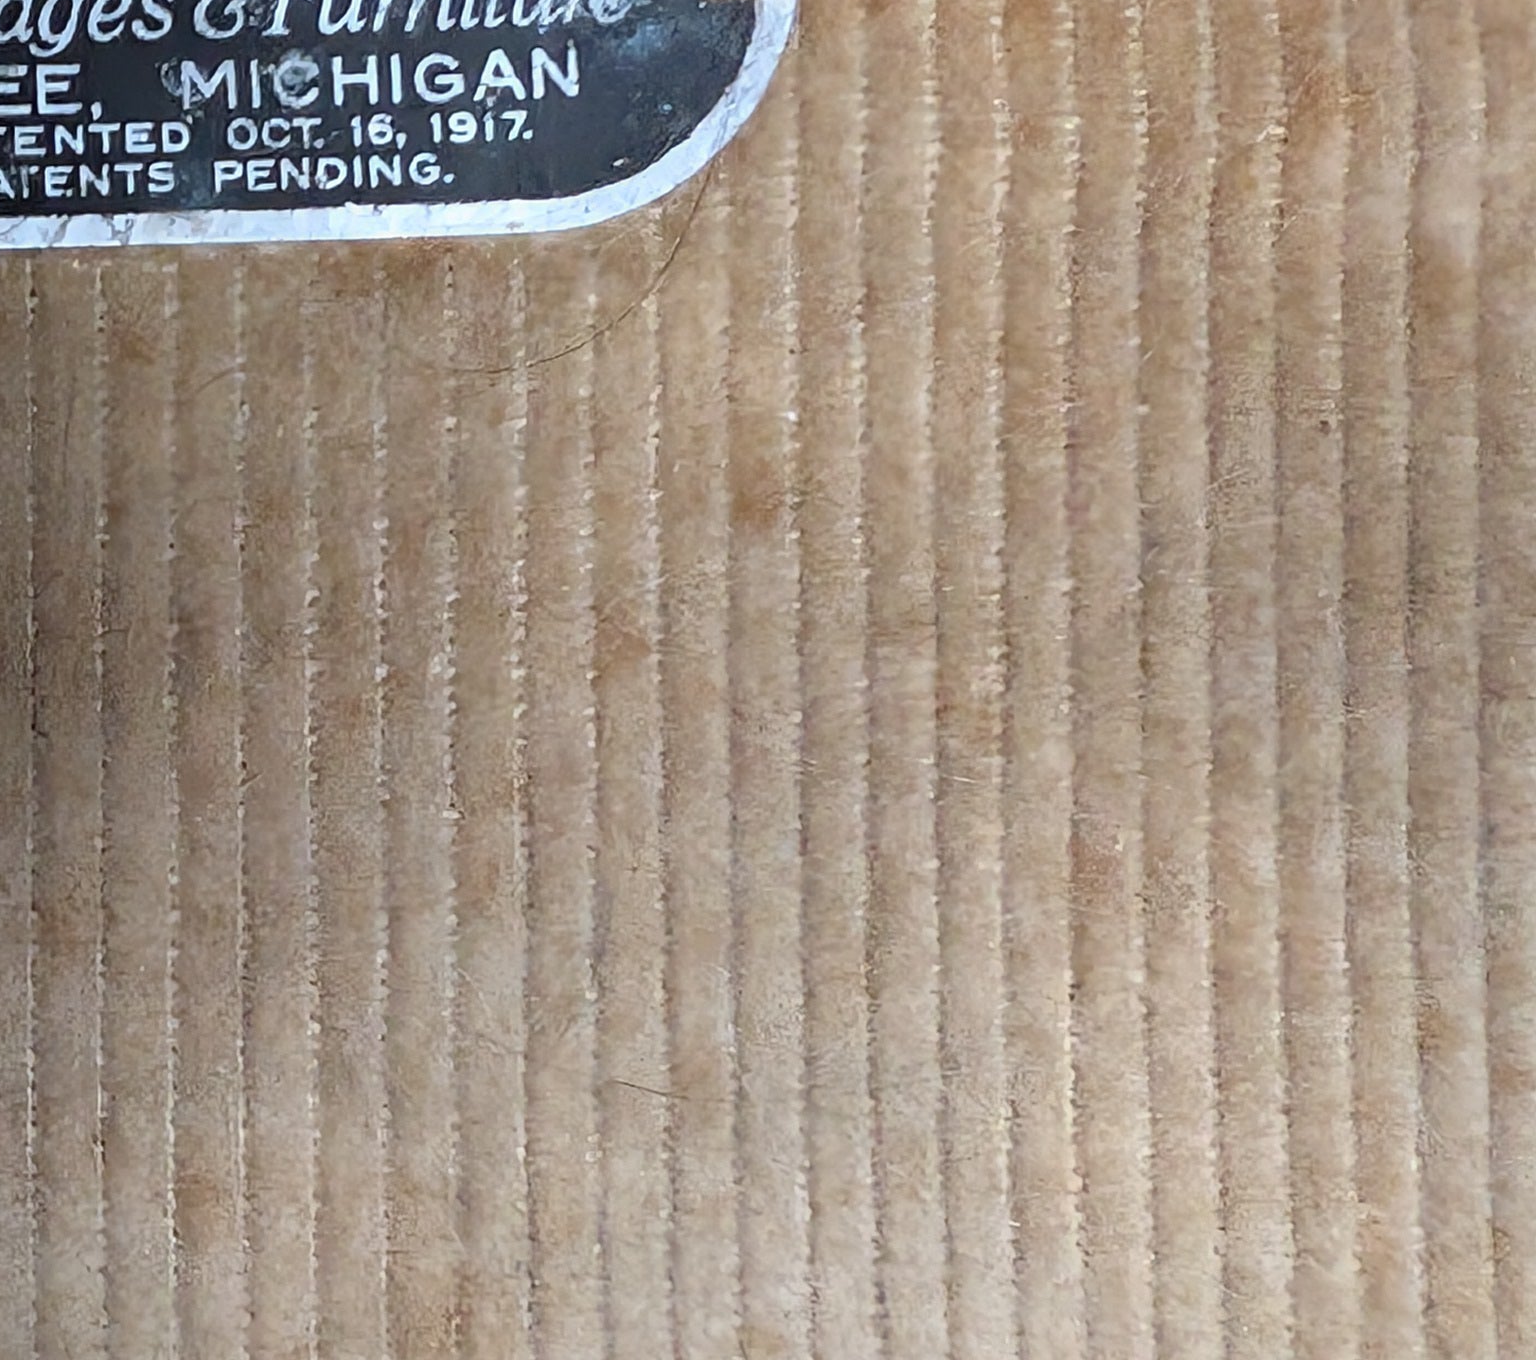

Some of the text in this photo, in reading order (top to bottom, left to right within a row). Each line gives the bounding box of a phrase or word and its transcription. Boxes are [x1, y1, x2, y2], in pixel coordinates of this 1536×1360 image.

[177, 41, 581, 113] MICHIGAN
[430, 112, 534, 144] 1917.
[213, 155, 456, 194] PENDING.
